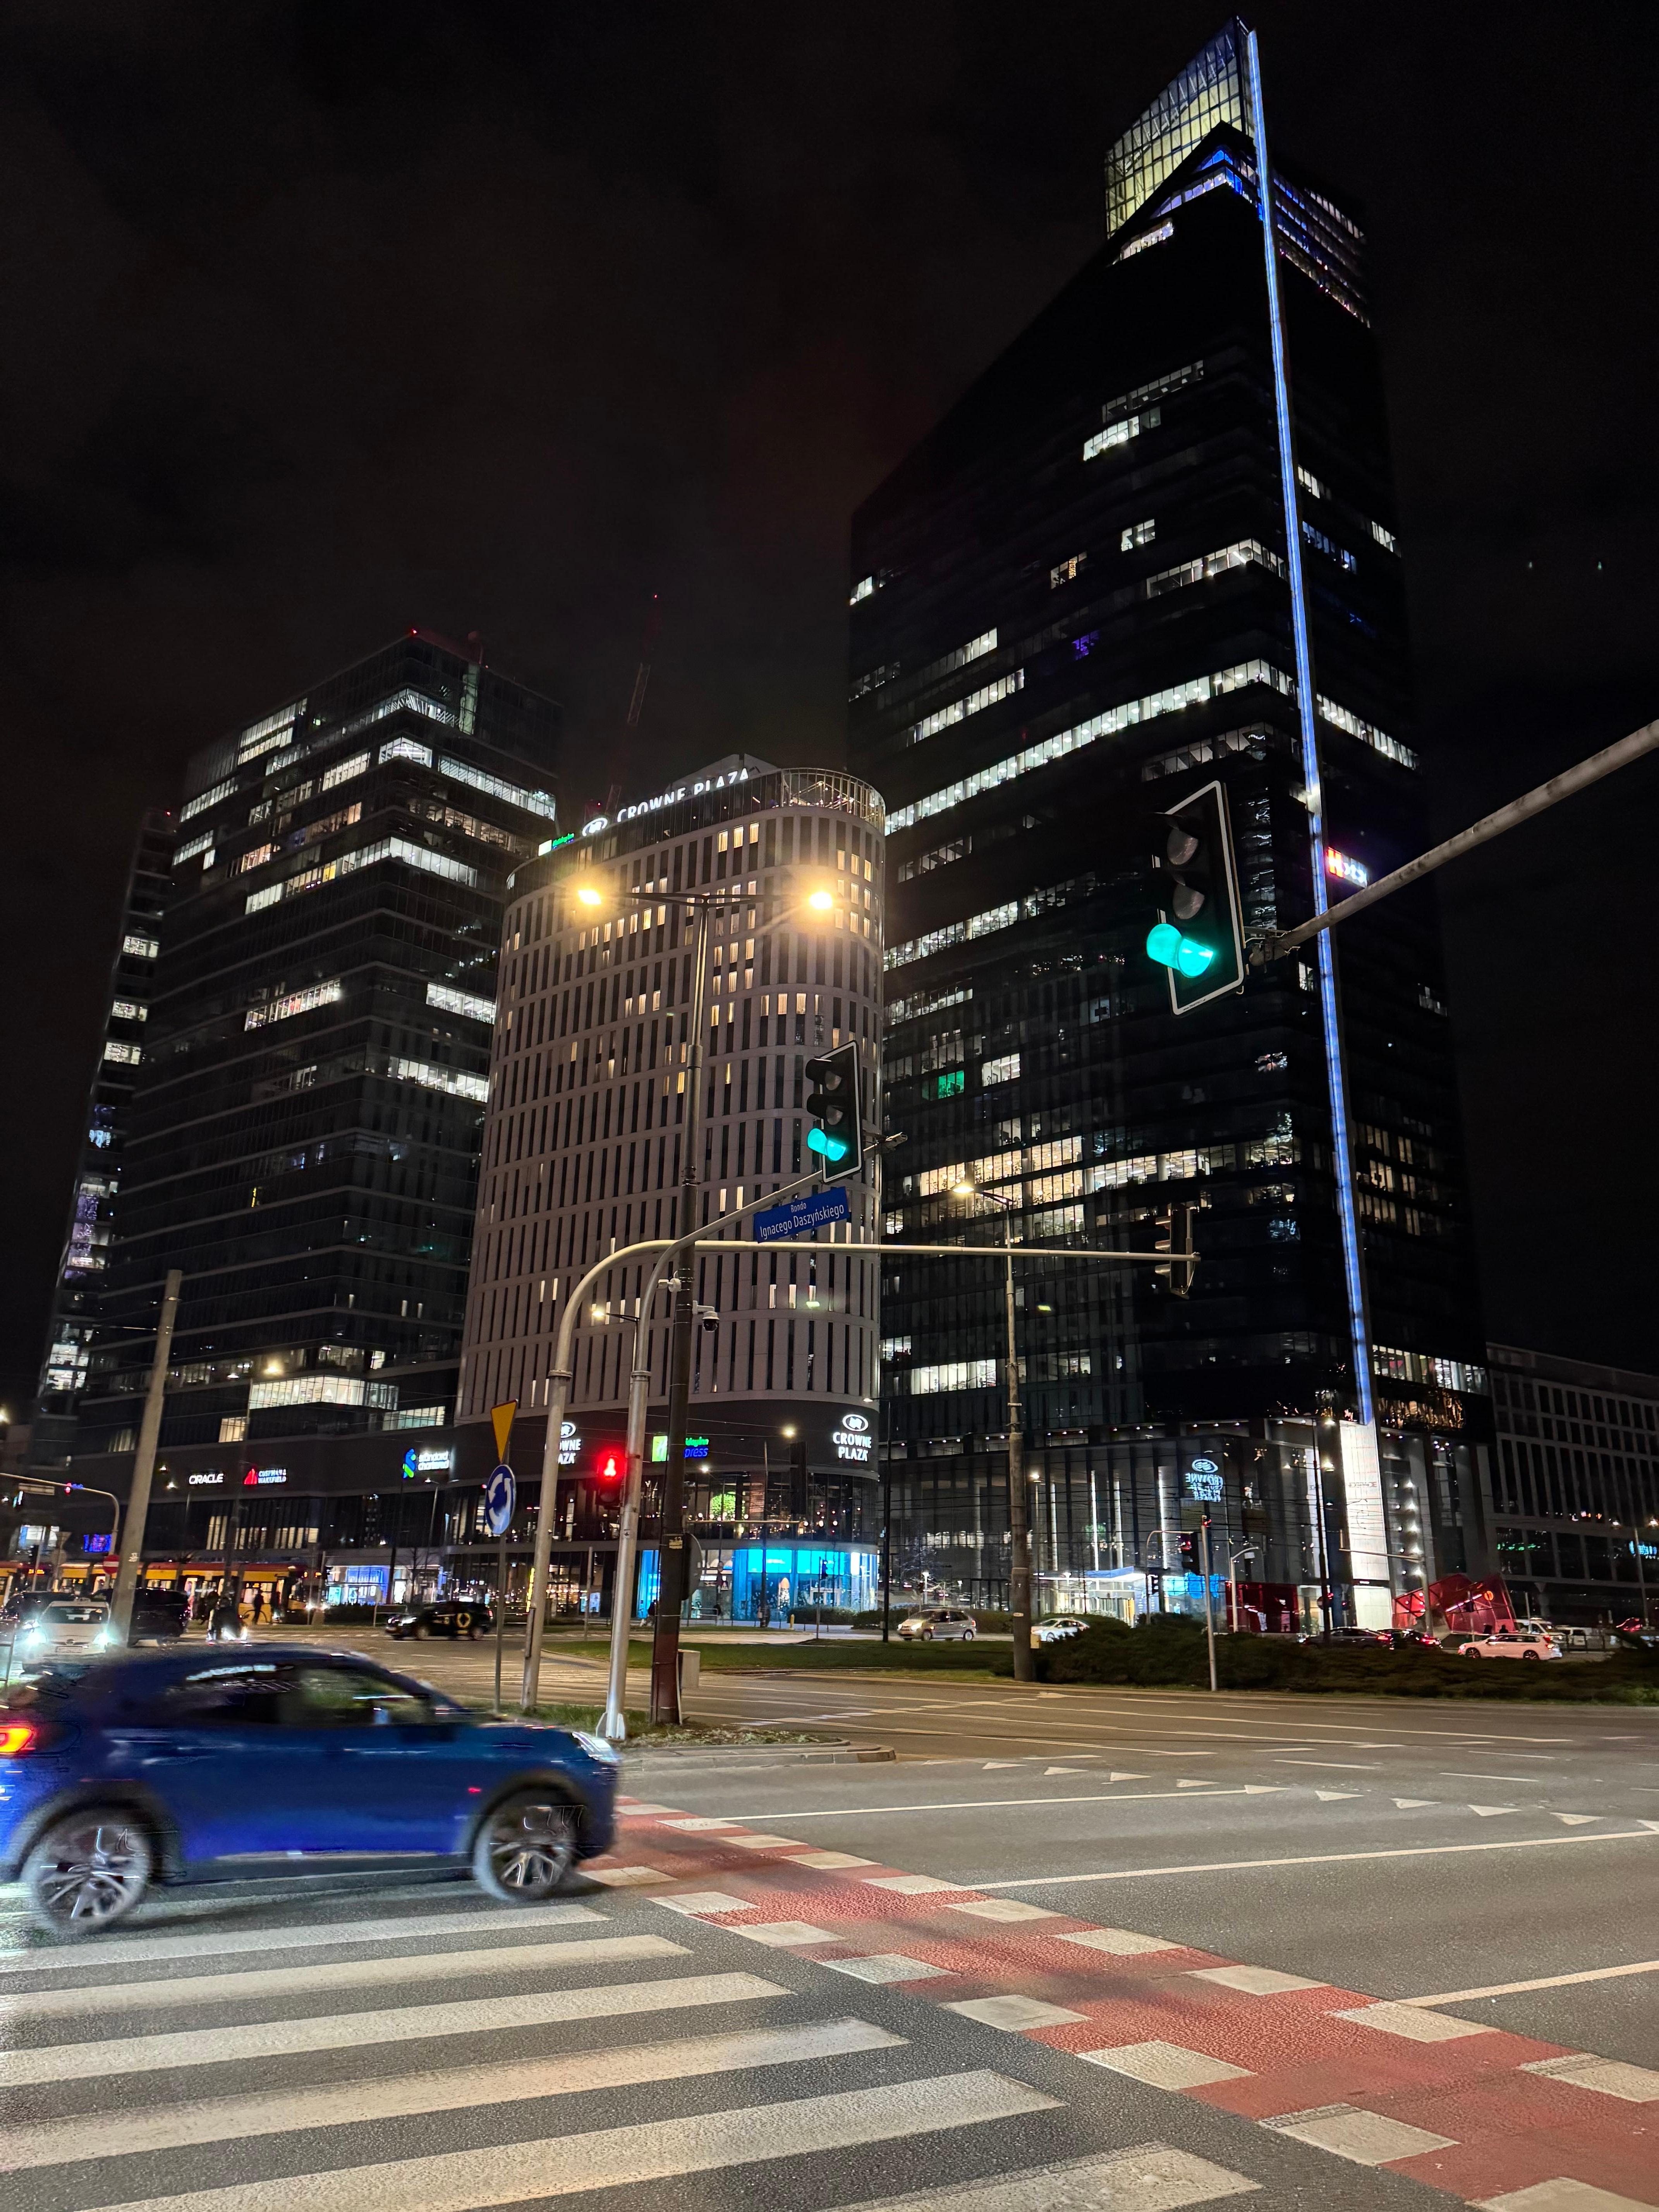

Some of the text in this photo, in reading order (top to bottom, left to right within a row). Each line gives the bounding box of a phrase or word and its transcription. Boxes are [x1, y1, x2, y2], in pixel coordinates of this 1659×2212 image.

[791, 1201, 807, 1213] Rondo
[760, 1204, 845, 1240] Ignacego Daszyńskiego
[833, 1432, 872, 1448] CROWNE
[558, 1453, 576, 1464] AZA
[684, 1448, 709, 1459] press
[838, 1446, 868, 1462] PLAZA
[189, 1473, 224, 1485] ORACLE
